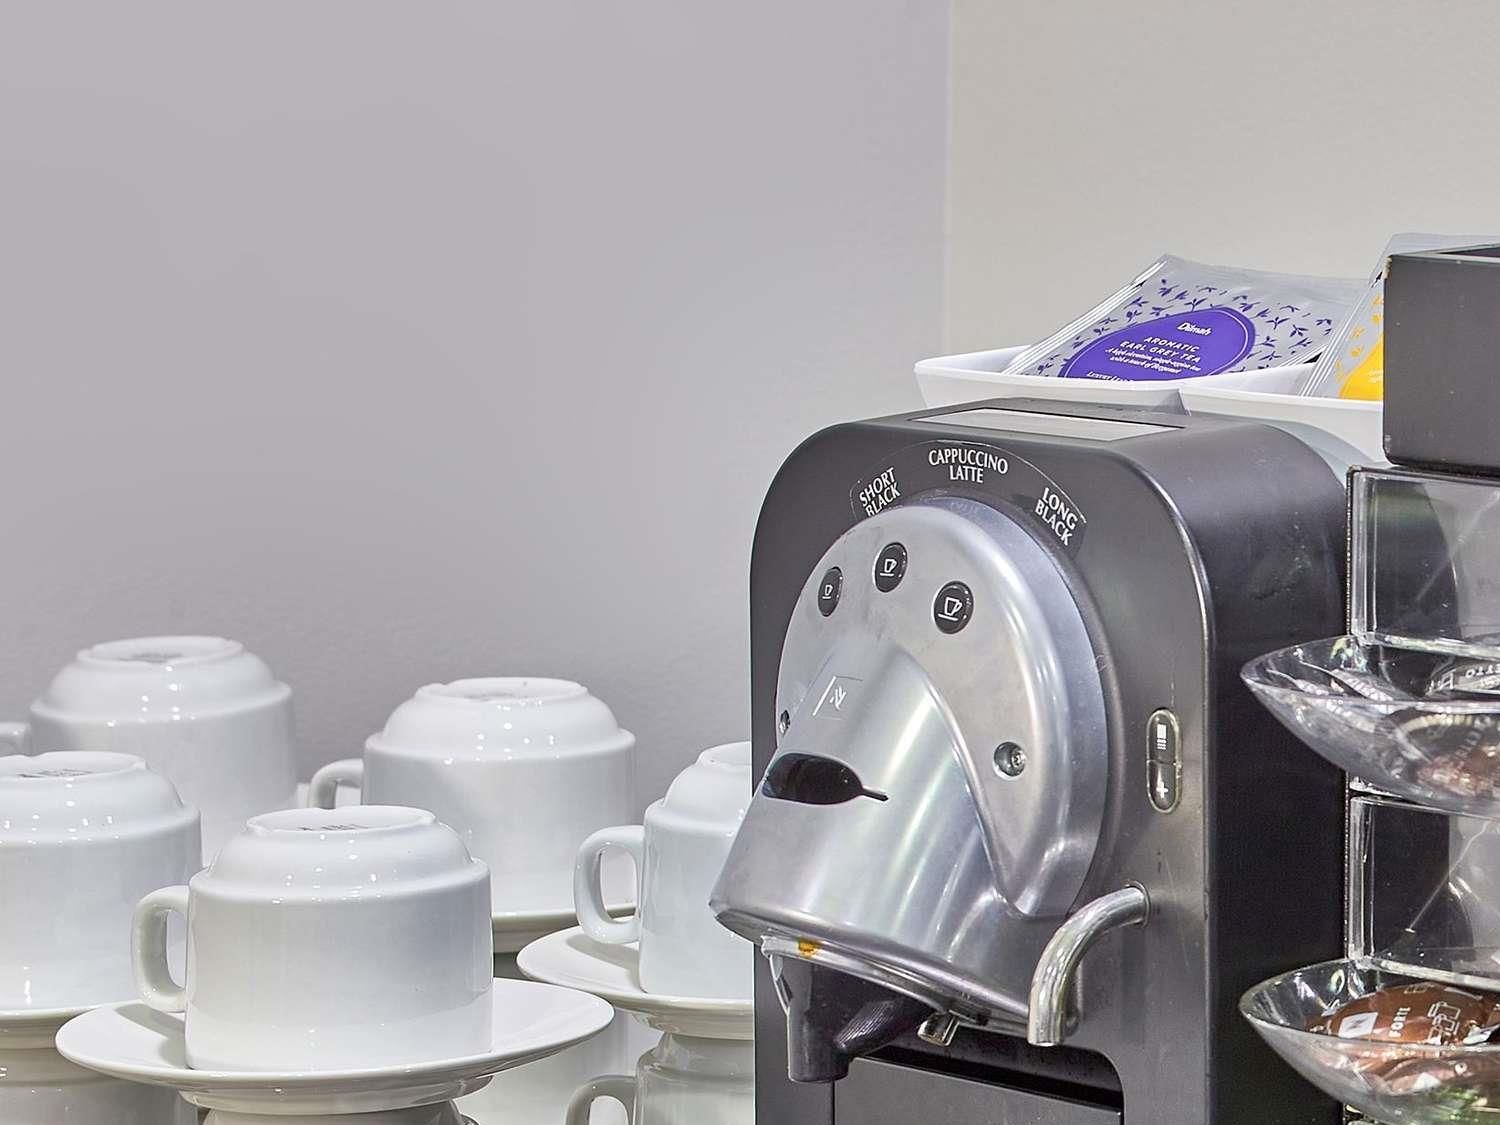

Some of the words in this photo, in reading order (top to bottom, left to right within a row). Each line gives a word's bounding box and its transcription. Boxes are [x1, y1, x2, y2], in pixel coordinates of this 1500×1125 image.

[1177, 322, 1213, 336] Dilmah
[1120, 341, 1147, 351] EARL
[1149, 347, 1179, 357] GREY
[1180, 353, 1201, 363] TEA
[1143, 336, 1200, 352] AROMATIC
[928, 449, 1008, 475] CAPPUCCINO
[949, 465, 984, 483] LATTE
[859, 467, 896, 507] SHORT
[865, 482, 901, 517] BLACK
[1043, 487, 1078, 531] LONG
[1034, 502, 1073, 546] BLACK
